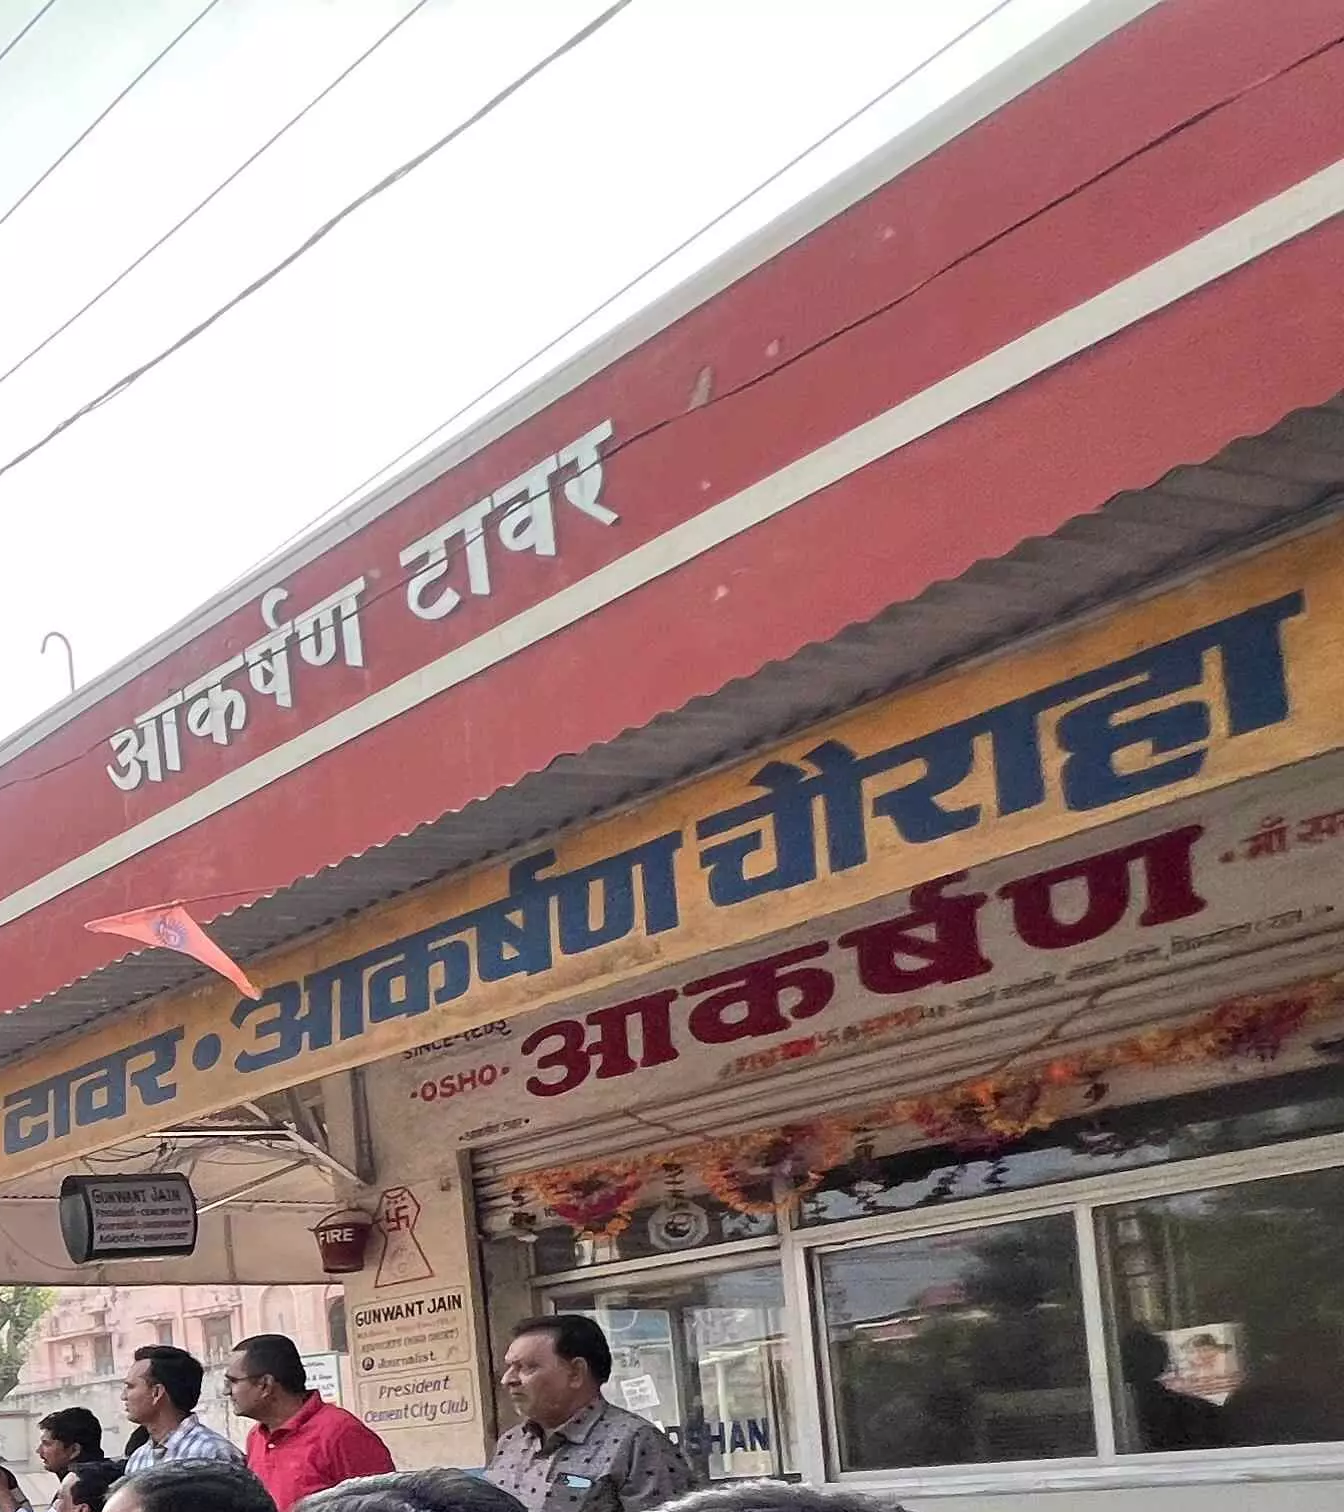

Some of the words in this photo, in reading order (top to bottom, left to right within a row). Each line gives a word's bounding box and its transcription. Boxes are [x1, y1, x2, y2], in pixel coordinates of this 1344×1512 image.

[107, 588, 366, 791] आकर्षण
[399, 419, 620, 621] टावर
[5, 1025, 185, 1155] टावर
[233, 849, 690, 1075] आकर्षण
[696, 590, 1306, 908] चौराहा
[520, 823, 1208, 1097] आकर्षण
[419, 1062, 499, 1101] OSHO
[318, 1227, 355, 1247] FIRE
[355, 1300, 425, 1328] GUNWANT
[427, 1294, 463, 1315] JAIN
[378, 1375, 450, 1400] President
[410, 1401, 439, 1421] City
[440, 1396, 469, 1415] Club
